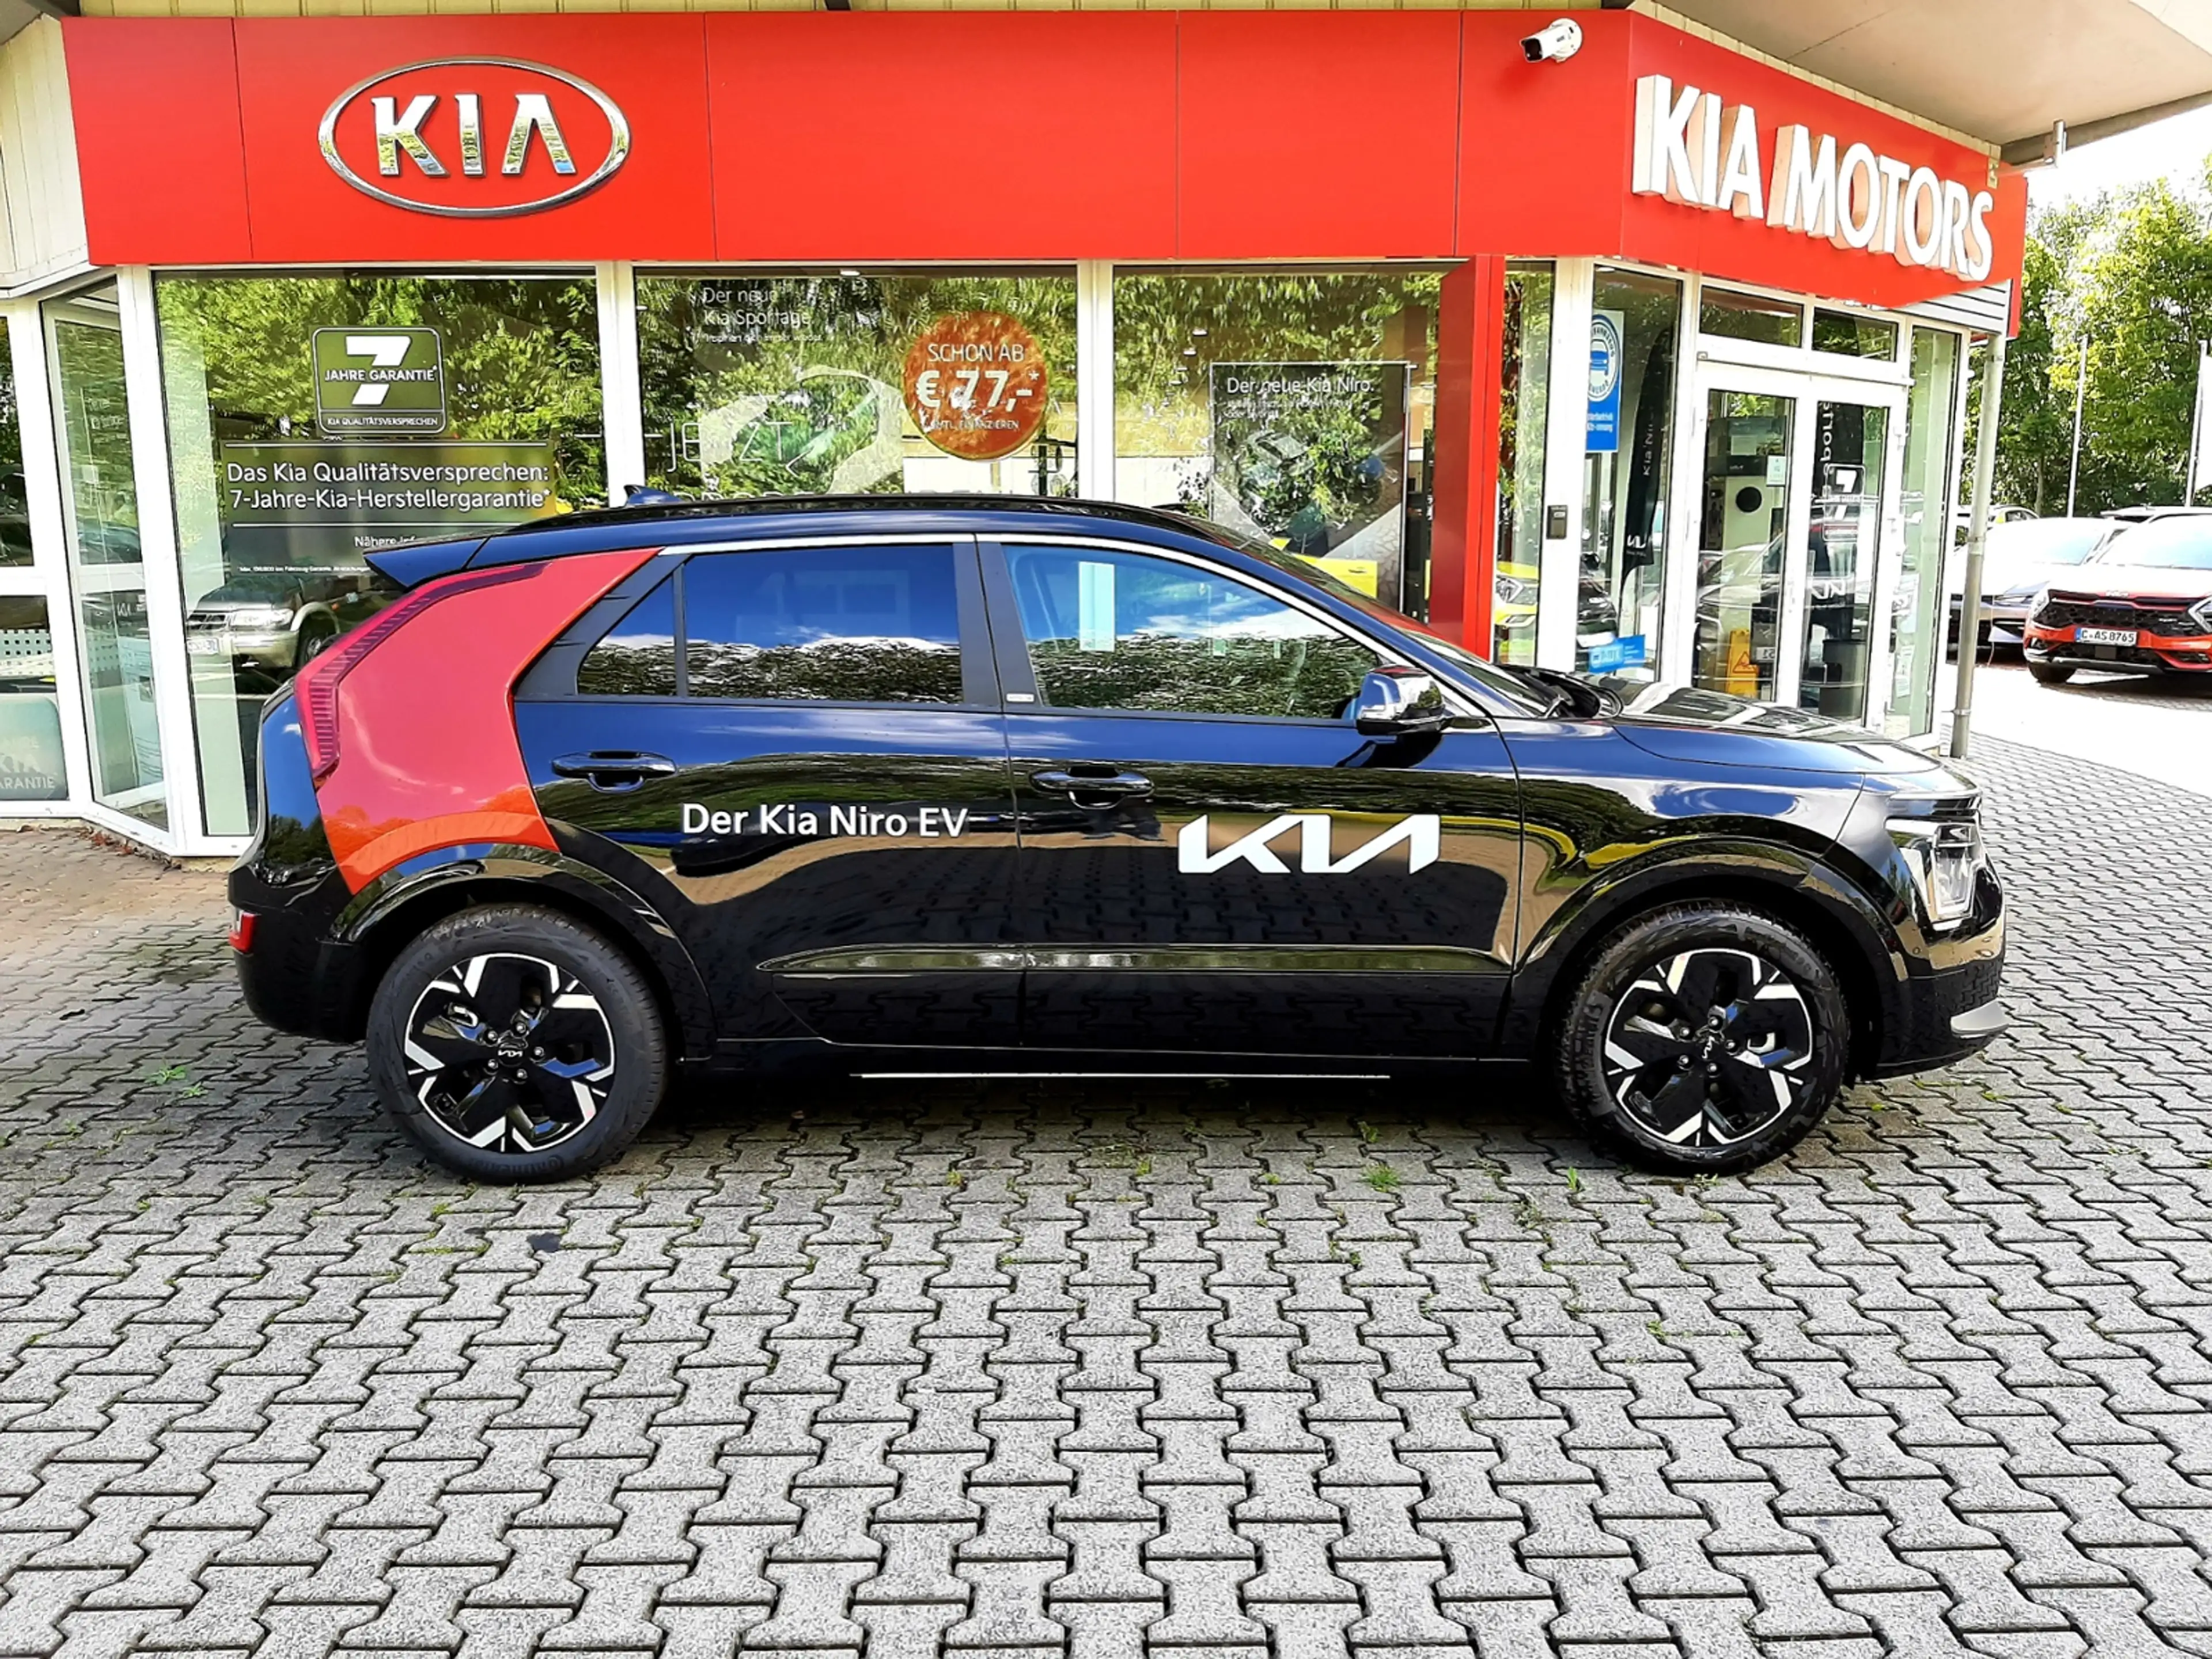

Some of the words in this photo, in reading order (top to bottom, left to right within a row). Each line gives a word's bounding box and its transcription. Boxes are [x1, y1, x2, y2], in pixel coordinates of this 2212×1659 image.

[371, 93, 578, 176] KIA
[1633, 74, 1763, 219] KIA
[1766, 123, 1994, 282] MOTORS
[703, 287, 732, 304] Der
[738, 289, 778, 303] neue
[704, 310, 730, 325] Kia
[736, 309, 812, 329] Sportage
[928, 343, 993, 362] SCHON
[998, 343, 1025, 362] AB
[324, 369, 365, 381] JAHRE
[346, 336, 412, 405] 7
[916, 370, 941, 408] €
[1227, 377, 1254, 393] Der
[1261, 381, 1301, 393] neue
[1307, 377, 1331, 392] Kia
[1338, 377, 1374, 392] Niro.
[327, 418, 341, 426] KIA
[342, 416, 438, 426] QUALITÄTSVERSPRECHEN
[959, 419, 1019, 430] FINANZIEREN
[666, 422, 793, 473] JEZT
[228, 463, 267, 482] Das
[274, 463, 307, 482] Kia
[313, 463, 550, 485] Qualitätsversprechen:
[354, 536, 396, 547] Nähere
[683, 803, 748, 835] Der
[760, 804, 817, 835] Kia
[830, 805, 908, 836] Niro
[919, 807, 968, 838] EV
[1177, 813, 1440, 875] KIA
